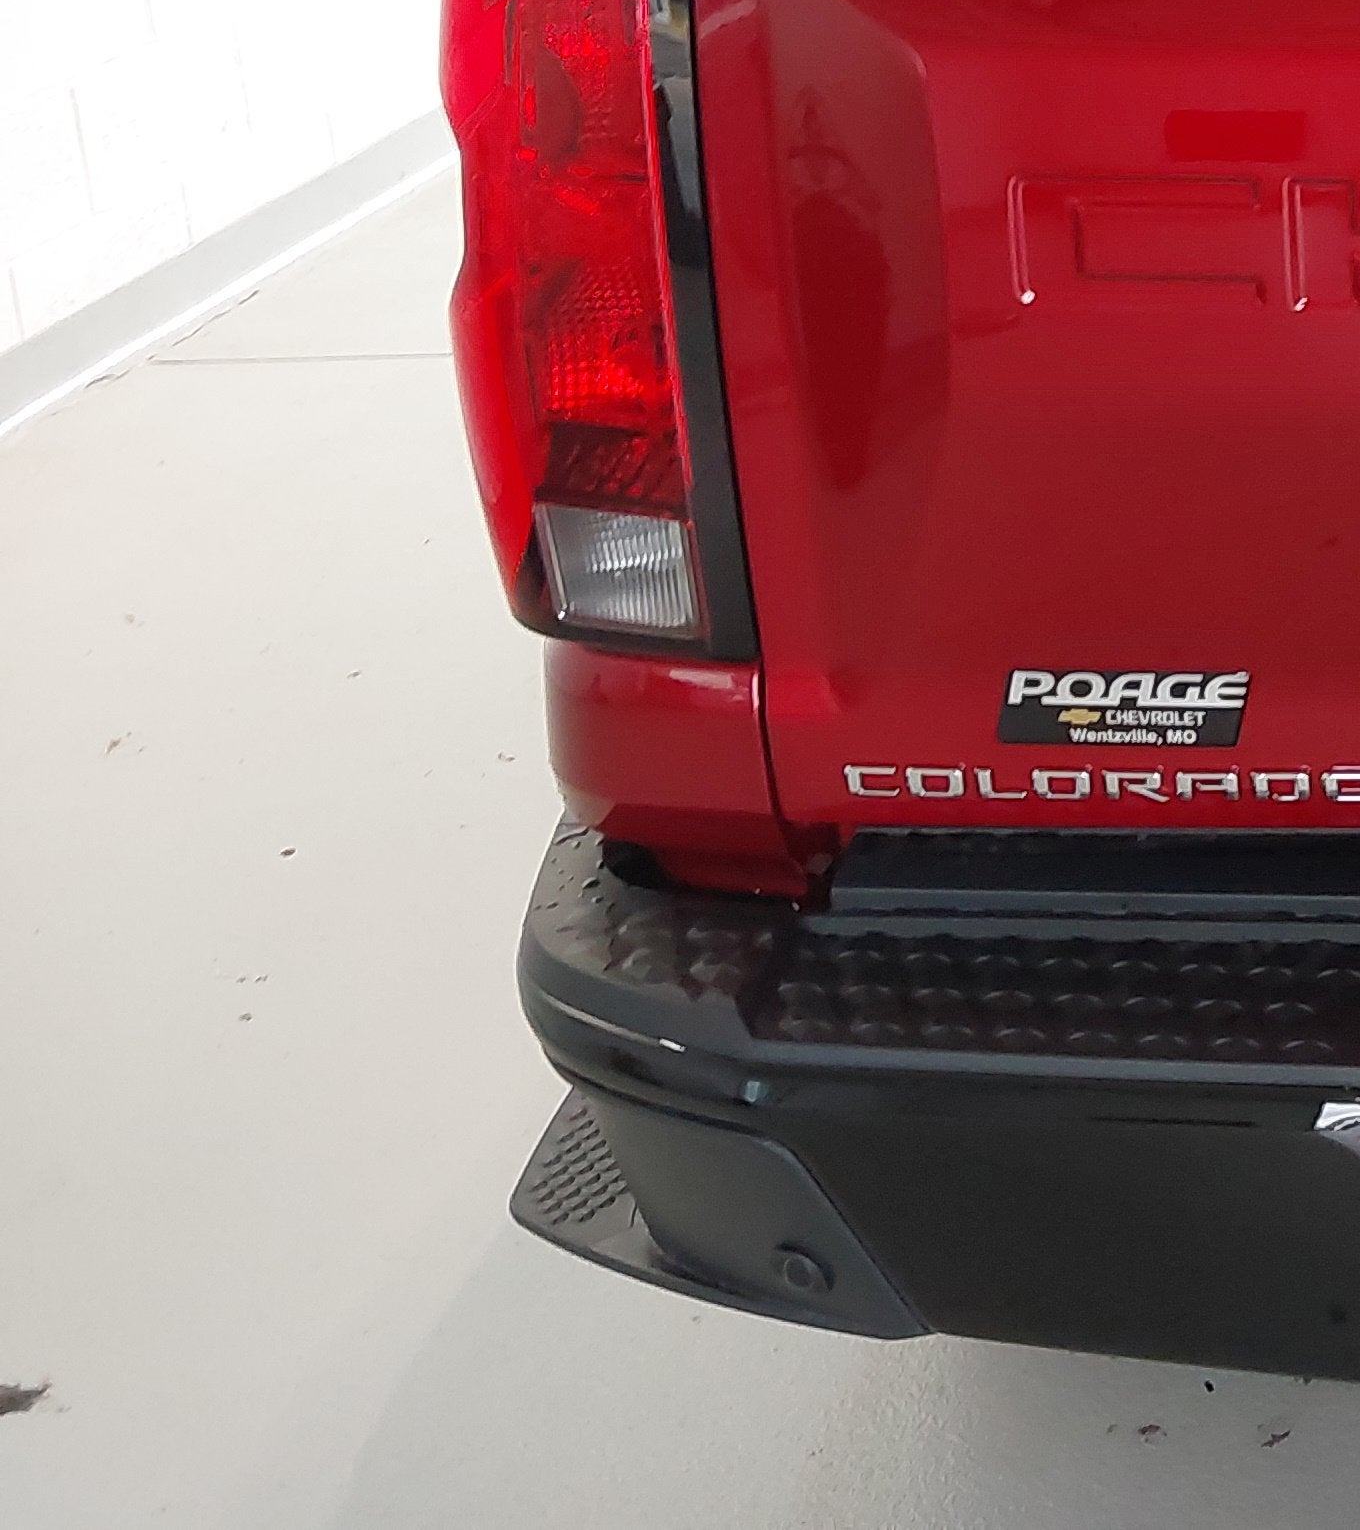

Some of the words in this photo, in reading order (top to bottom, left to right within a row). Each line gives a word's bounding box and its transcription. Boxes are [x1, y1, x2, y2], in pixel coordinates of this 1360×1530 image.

[1007, 669, 1250, 708] POAGE
[1105, 709, 1206, 726] CHEVROLET
[1069, 727, 1163, 746] Wentzville,
[1166, 729, 1197, 744] MO
